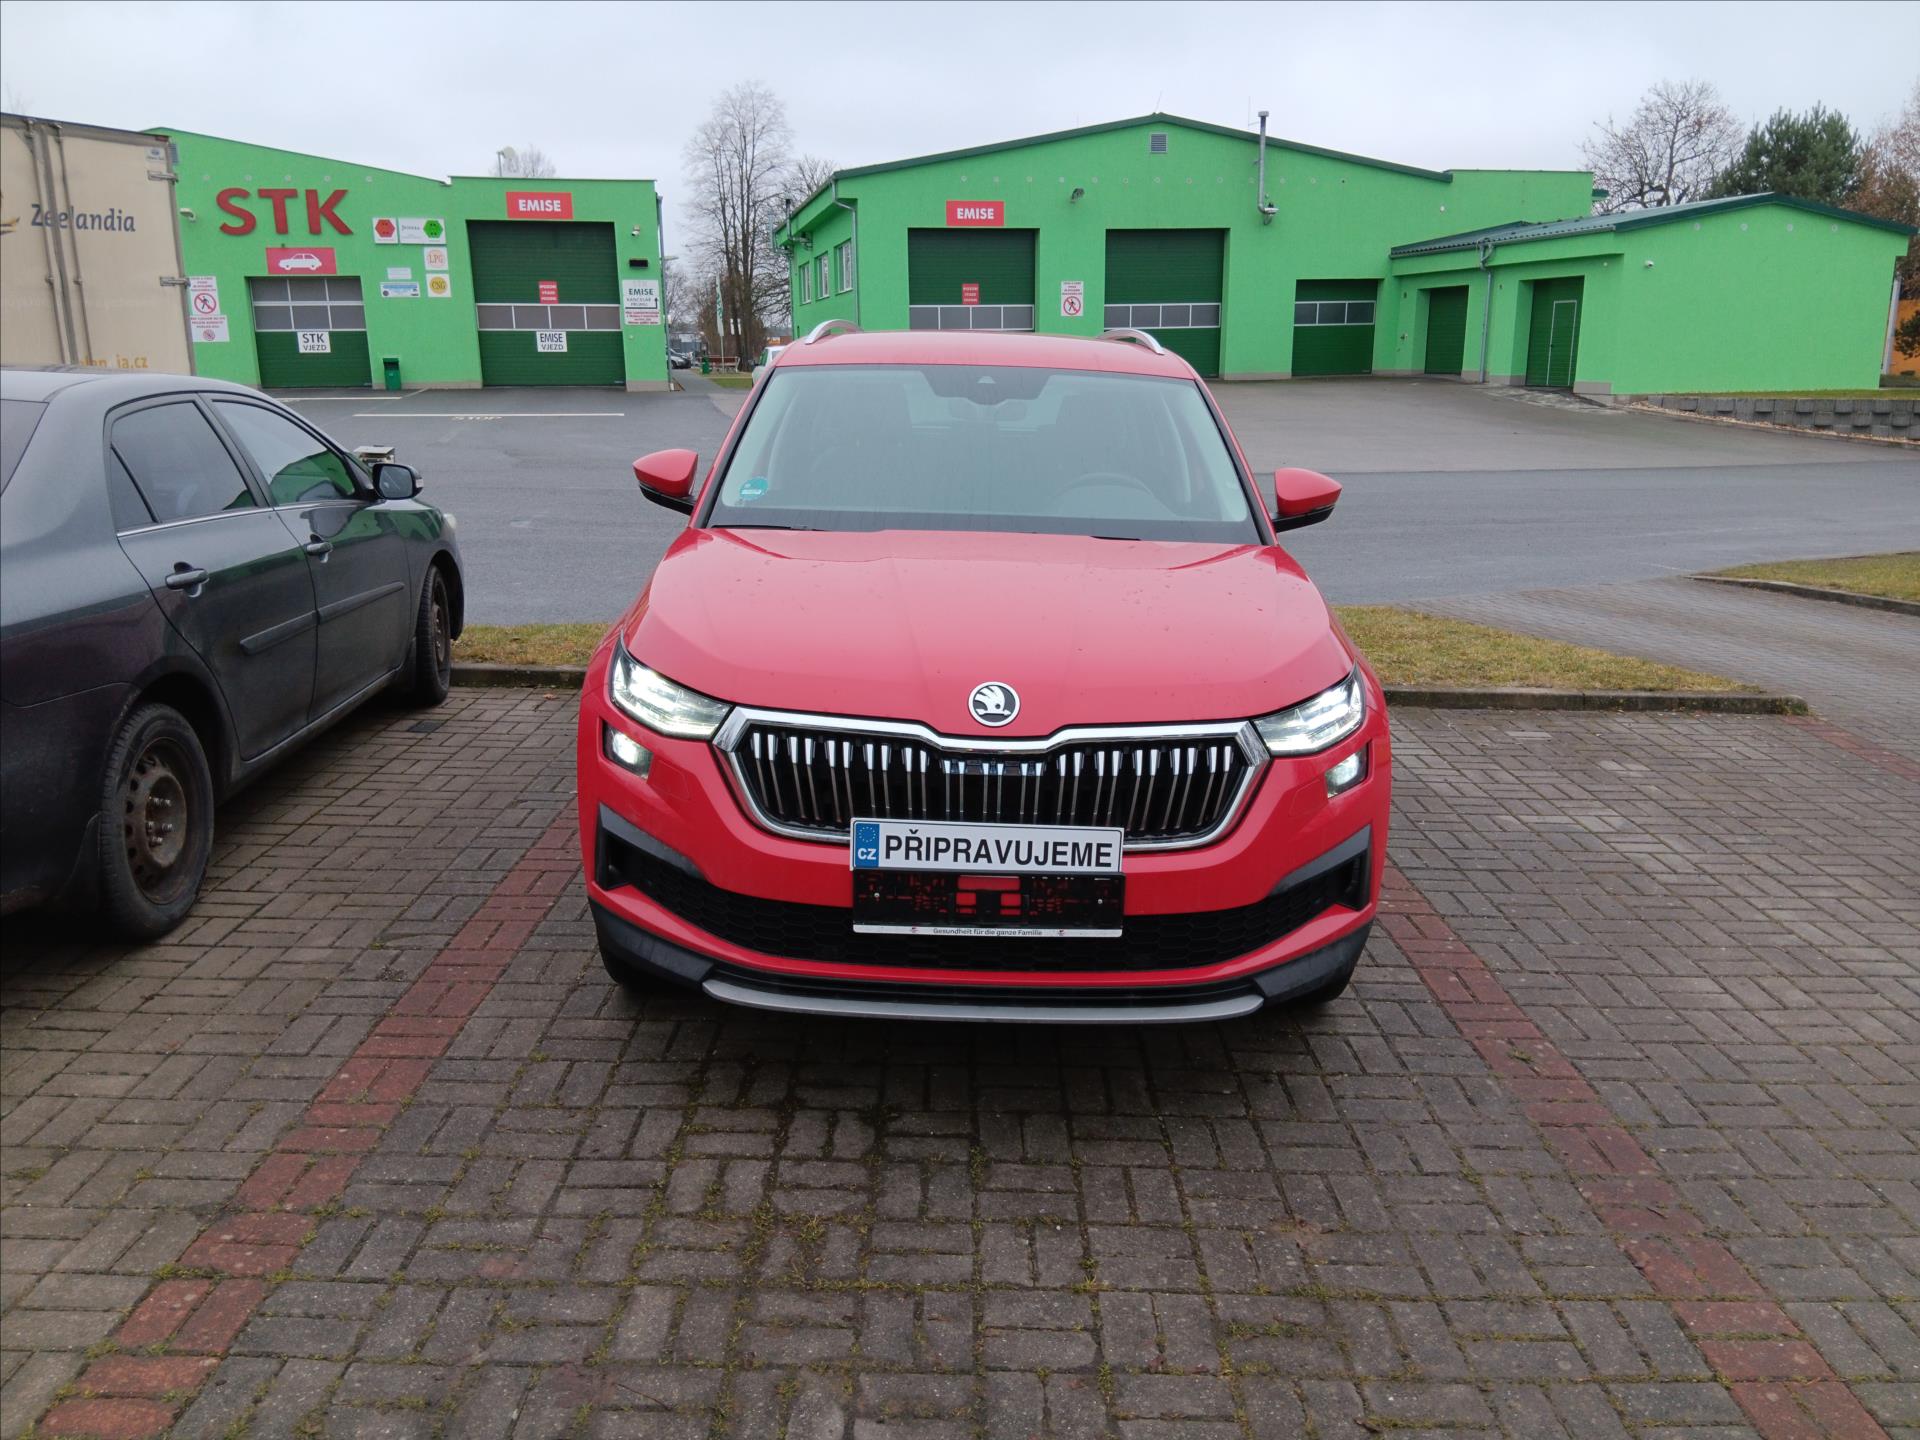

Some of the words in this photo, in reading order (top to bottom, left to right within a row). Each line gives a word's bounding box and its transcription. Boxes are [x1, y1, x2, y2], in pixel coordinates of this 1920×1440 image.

[216, 187, 354, 236] STK
[518, 199, 562, 212] EMISE
[31, 204, 136, 232] Zeelandia
[957, 207, 995, 220] EMISE
[628, 288, 654, 296] EMISE
[302, 333, 325, 343] STK
[540, 333, 563, 343] EMISE
[857, 847, 877, 860] CZ
[885, 829, 1113, 868] PŘIPRAVUJEME
[933, 927, 972, 935] Gesundheit
[985, 928, 995, 936] die
[996, 929, 1016, 937] ganze
